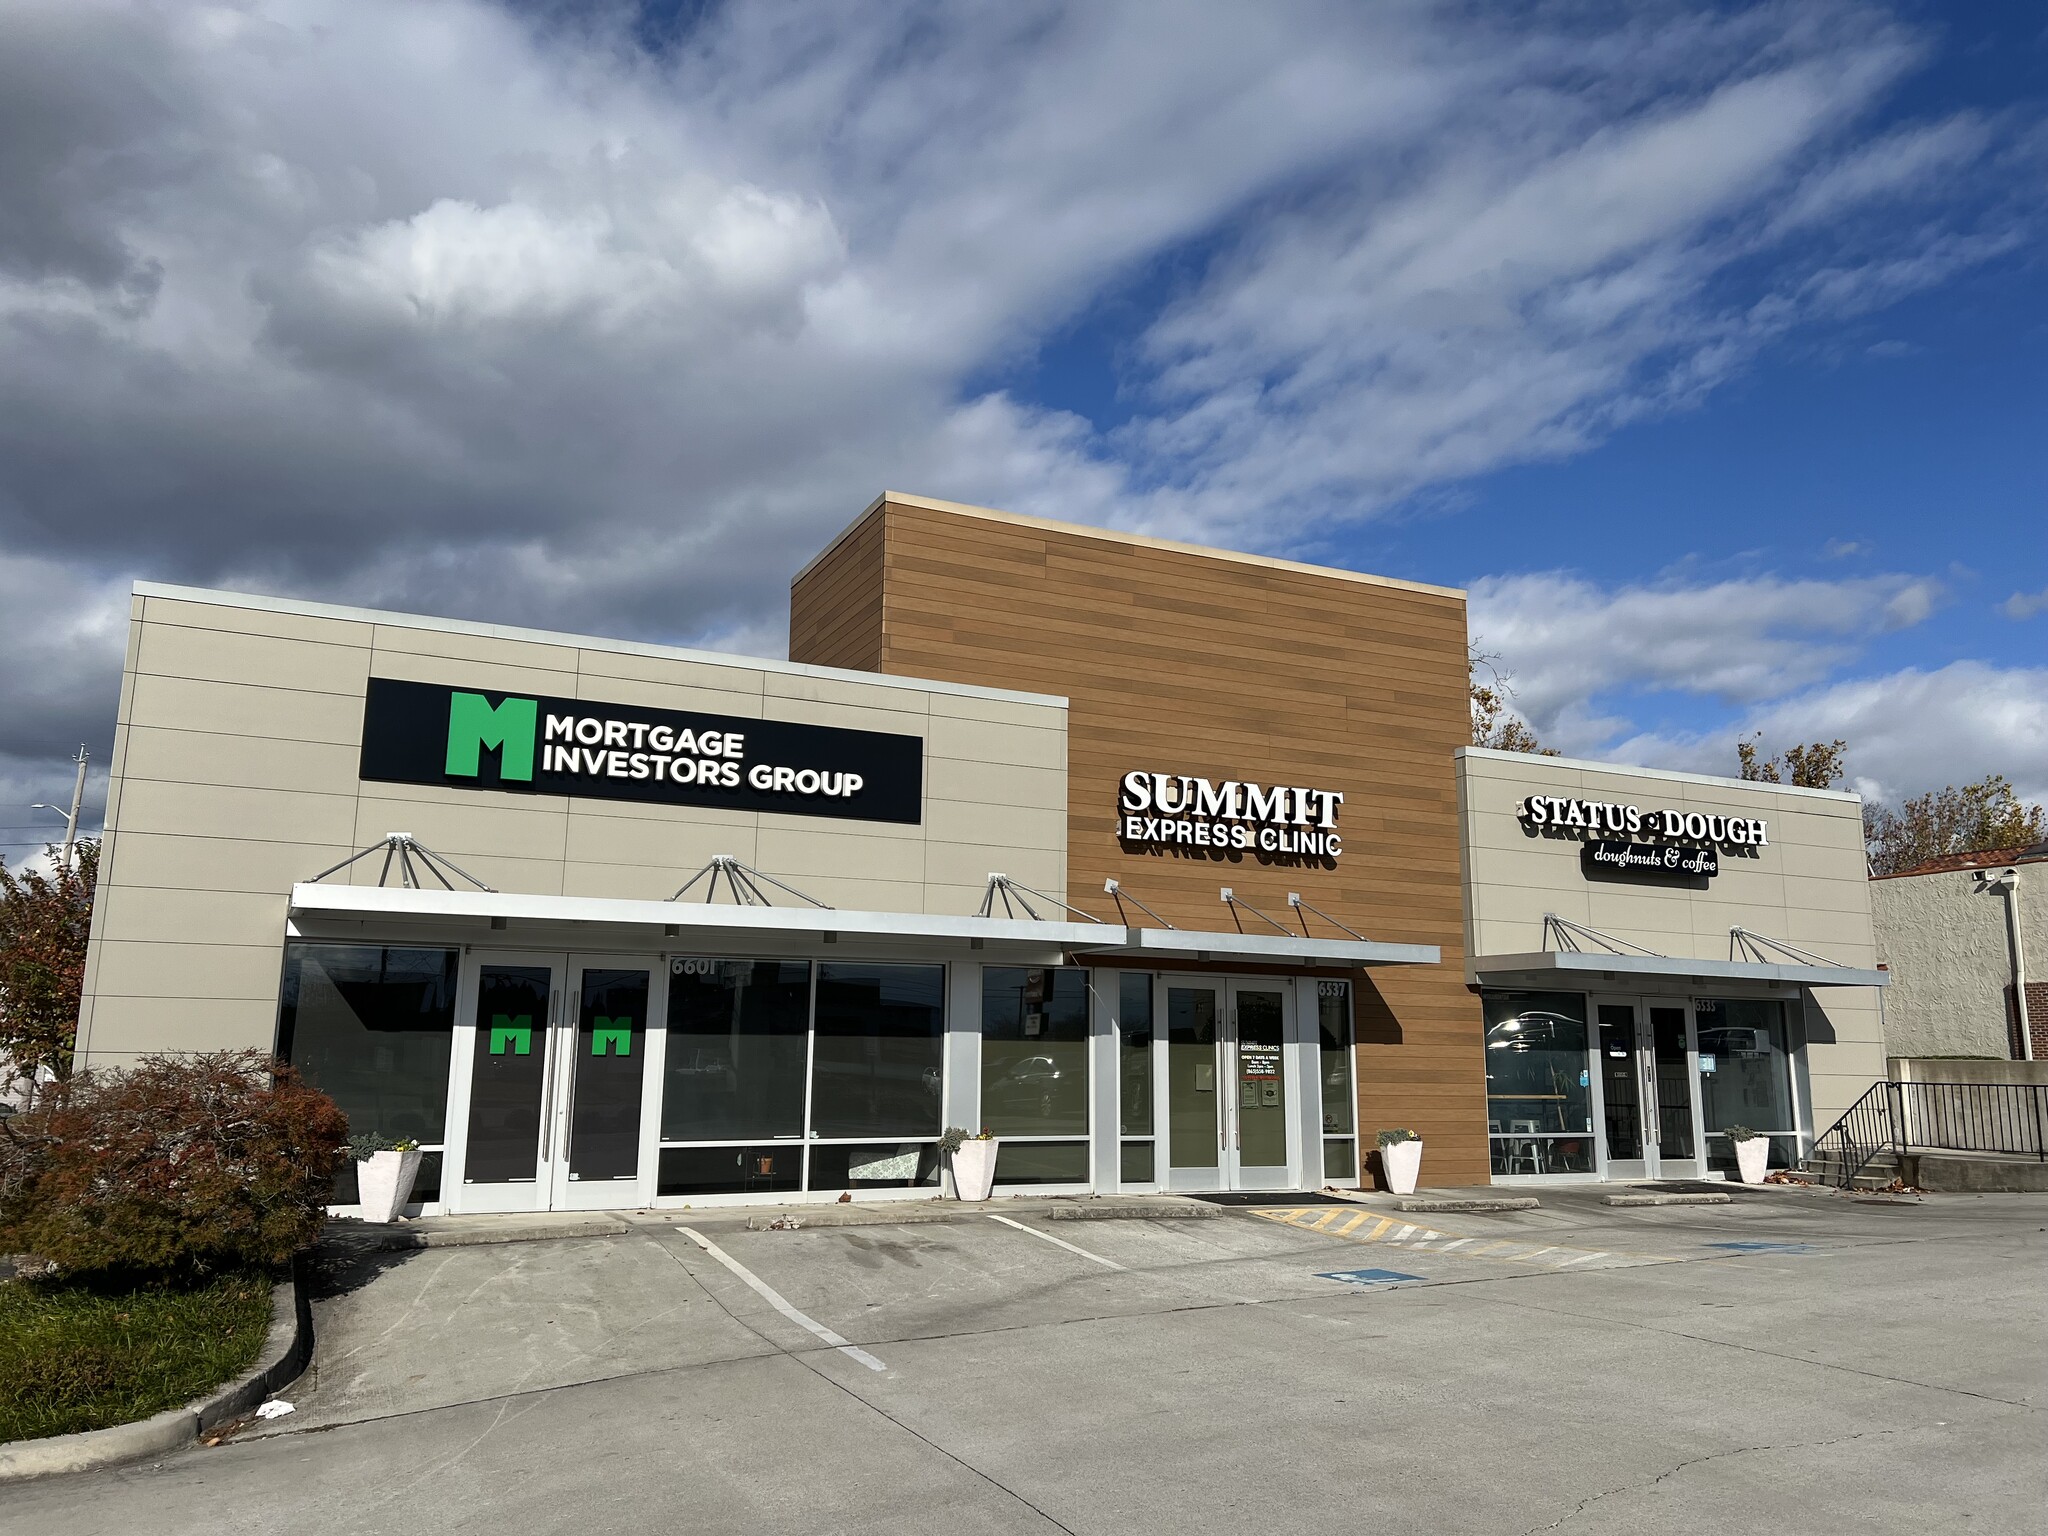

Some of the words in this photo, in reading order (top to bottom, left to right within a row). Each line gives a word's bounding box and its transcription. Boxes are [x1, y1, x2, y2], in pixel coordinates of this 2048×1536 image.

[444, 691, 538, 782] M
[544, 714, 745, 759] MORTGAGE
[542, 745, 740, 787] INVESTORS
[748, 764, 864, 798] GROUP
[1122, 771, 1344, 829] SUMMIT
[1531, 795, 1641, 832] STATUS
[1662, 809, 1769, 846] DOUGH
[1126, 816, 1248, 849] EXPRESS
[1260, 828, 1343, 857] CLINIC
[1594, 842, 1661, 867] doughnuts
[1664, 848, 1680, 868] &
[1682, 851, 1716, 873] coffee
[672, 957, 715, 975] 6601
[1318, 982, 1346, 997] 6537
[1695, 999, 1716, 1012] 6535
[489, 1014, 532, 1055] M
[591, 1016, 632, 1056] M
